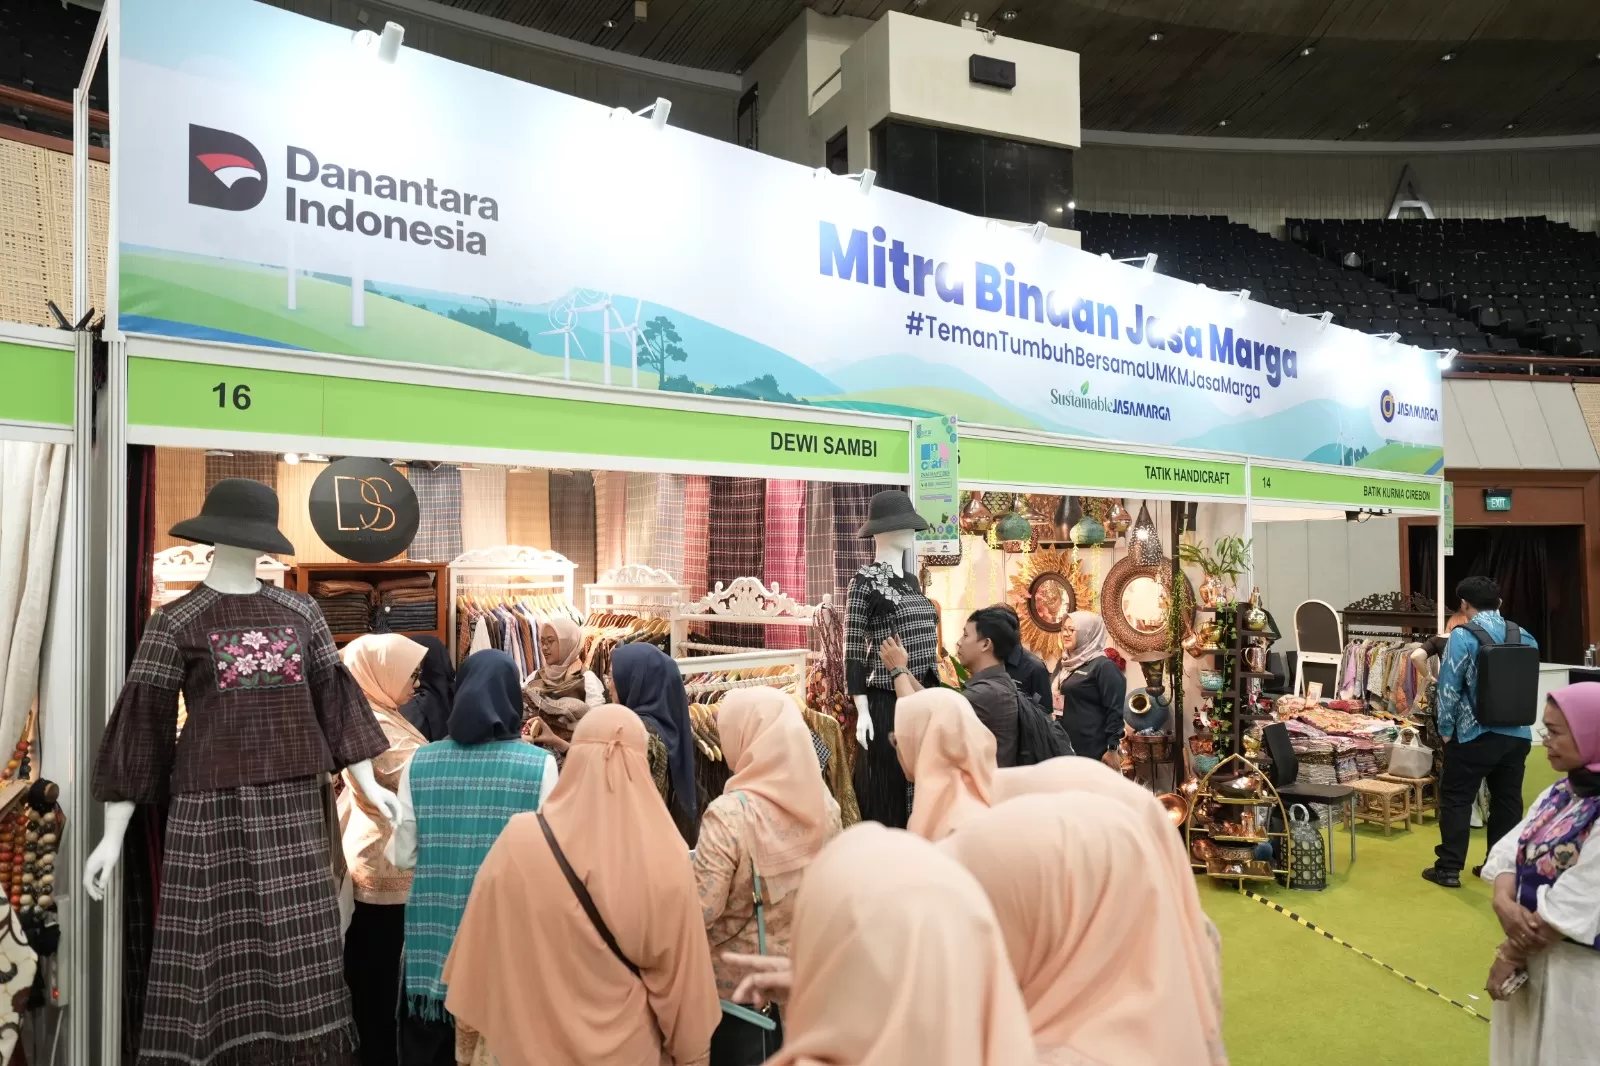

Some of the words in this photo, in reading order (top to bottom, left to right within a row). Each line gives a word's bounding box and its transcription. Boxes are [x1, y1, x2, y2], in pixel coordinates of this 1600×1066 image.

[286, 145, 499, 222] Danantara
[286, 186, 487, 257] Indonesia
[819, 220, 965, 306] Mitra
[1209, 323, 1298, 388] Marga
[905, 310, 1261, 403] #TemanTumbuhBersamaUMKMJasaMarga
[212, 382, 251, 410] 16
[770, 431, 818, 453] DEWI
[823, 436, 877, 457] SAMBI
[1144, 465, 1172, 480] TATIK
[1173, 468, 1230, 485] HANDICRAFT
[1262, 476, 1271, 489] 14
[1363, 485, 1382, 497] BATIK
[1382, 487, 1405, 499] KURNIA
[1405, 489, 1431, 501] CIREBON
[1491, 498, 1506, 508] EXIT
